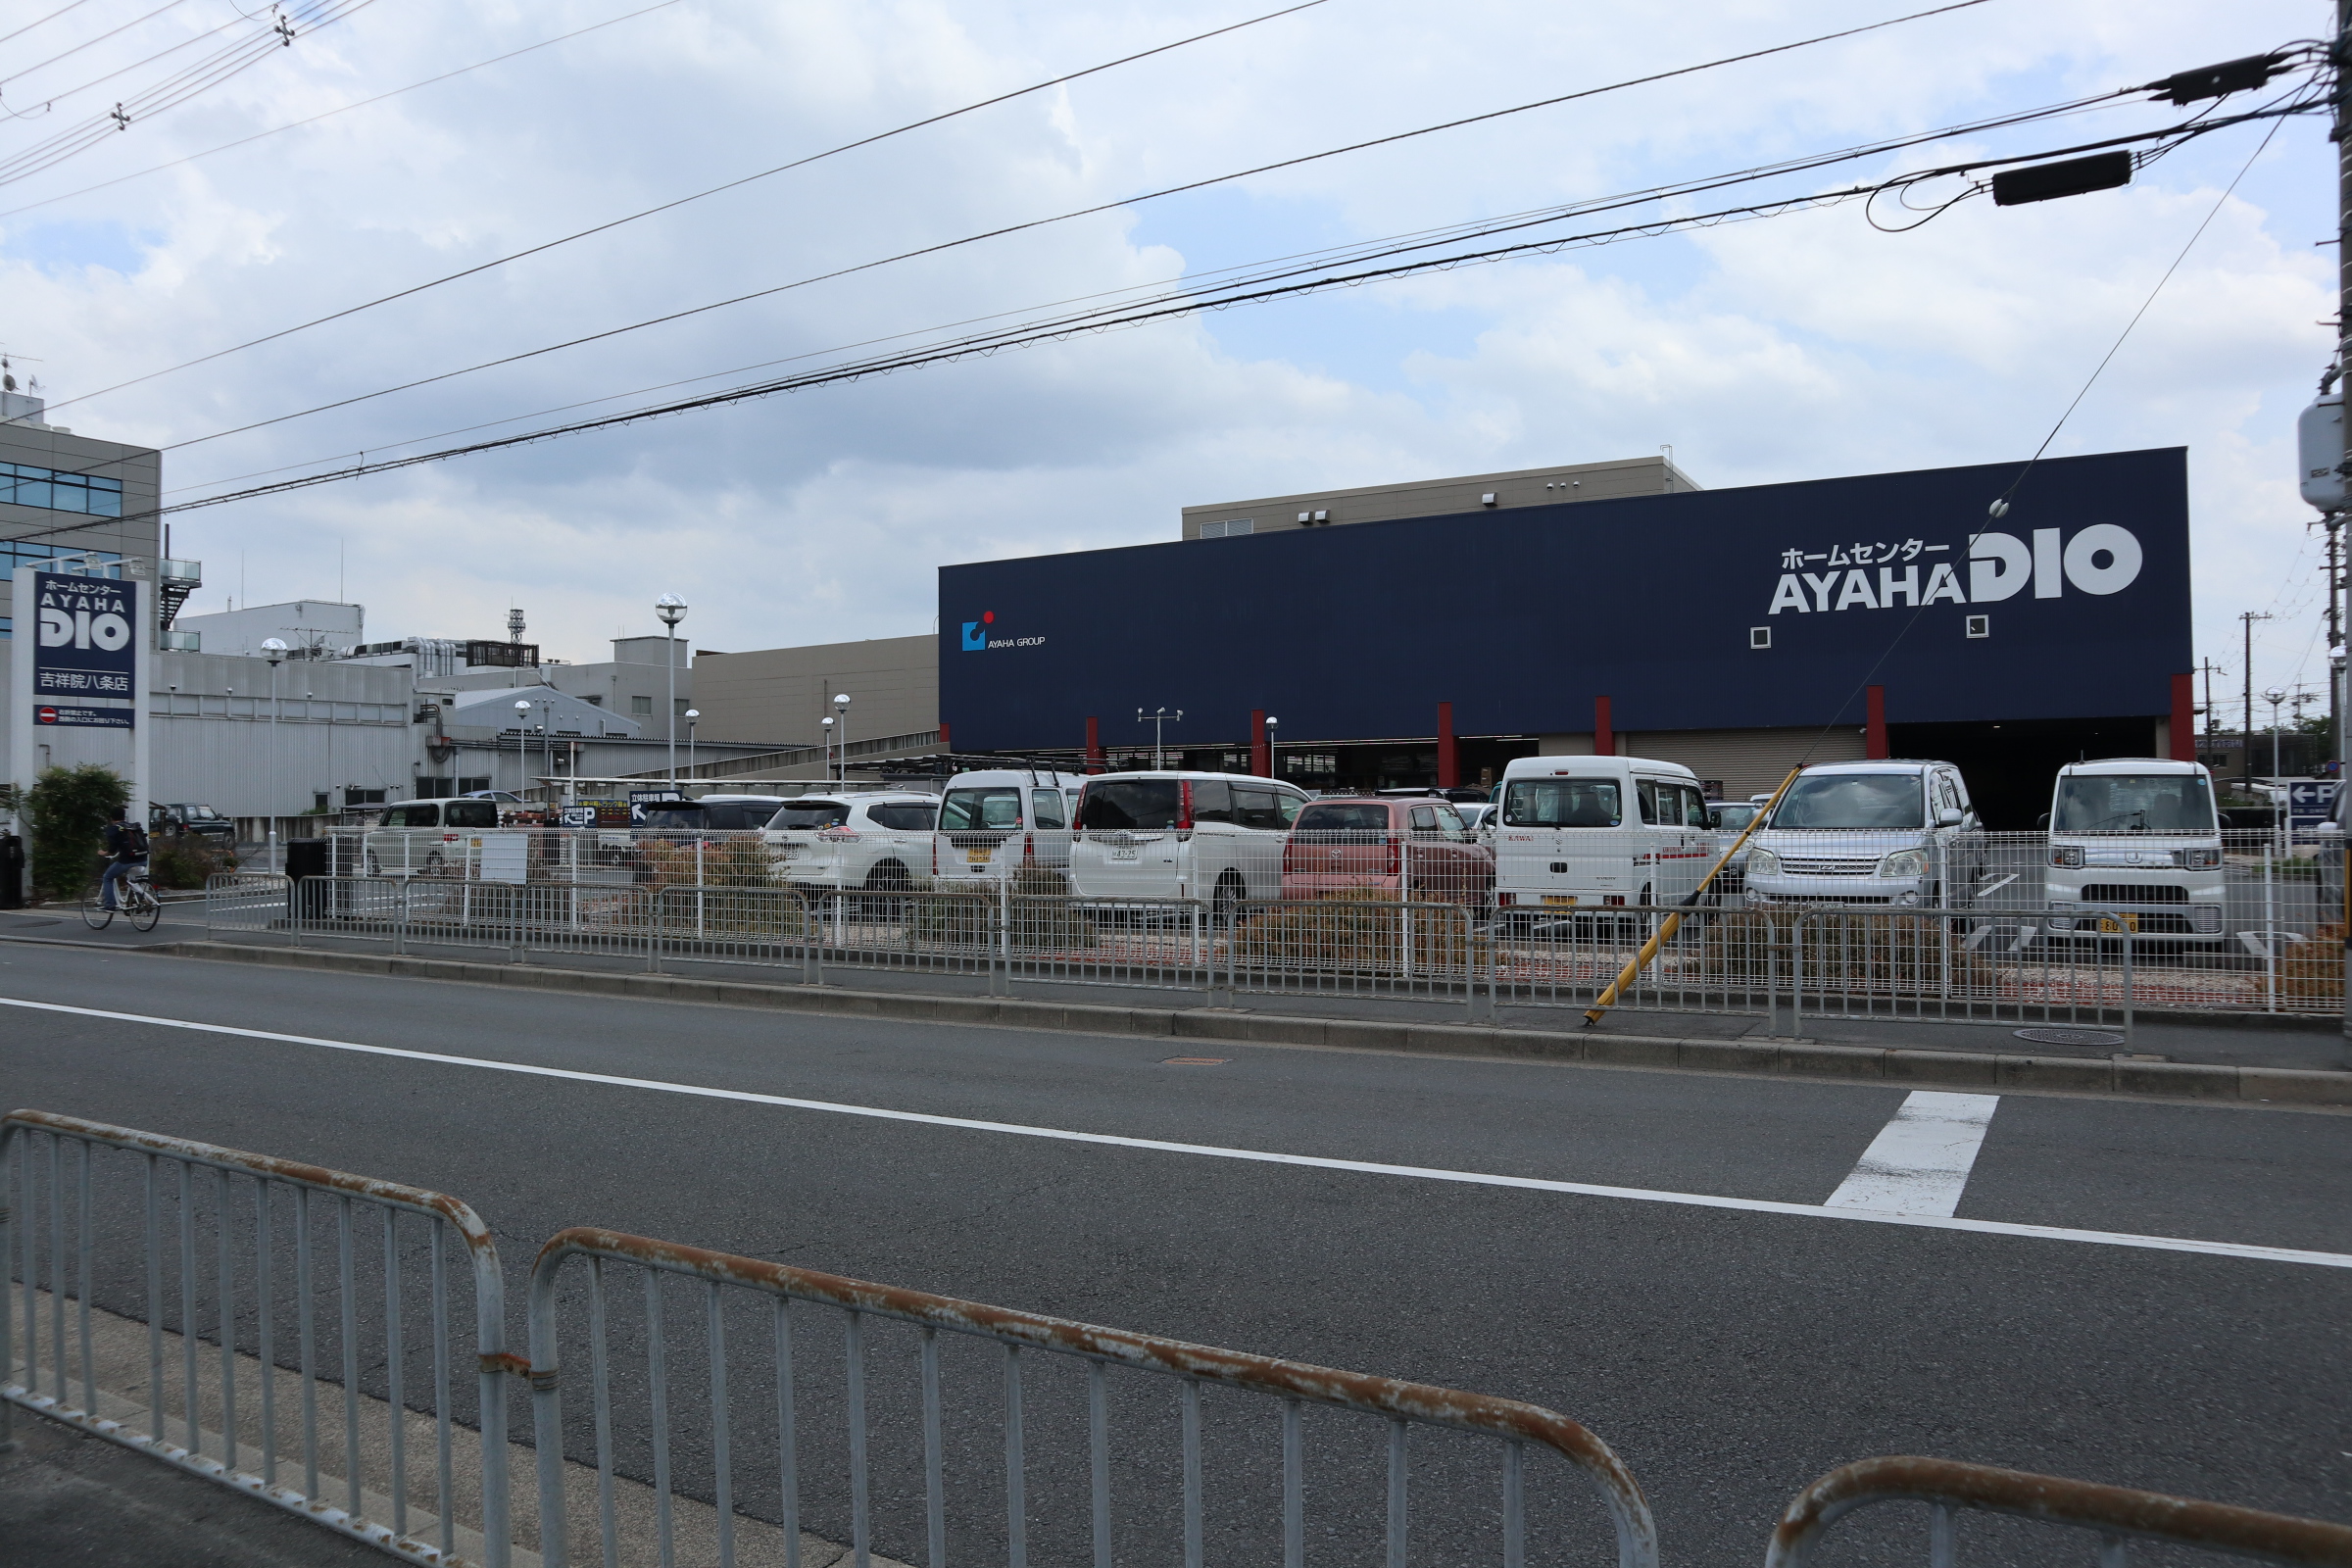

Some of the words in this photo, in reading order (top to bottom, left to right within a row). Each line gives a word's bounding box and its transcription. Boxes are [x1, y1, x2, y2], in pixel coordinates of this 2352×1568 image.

[1781, 538, 1950, 569] ホームセンター
[1768, 563, 1967, 614] AYAHA
[1969, 523, 2143, 603] DIO
[45, 579, 122, 595] ホームセンター
[40, 592, 125, 613] AYAHA
[40, 607, 130, 652] DIO
[988, 639, 1014, 649] AYAHA
[1016, 636, 1046, 647] GROUP
[39, 672, 129, 692] 吉祥院八条店
[584, 807, 596, 824] P
